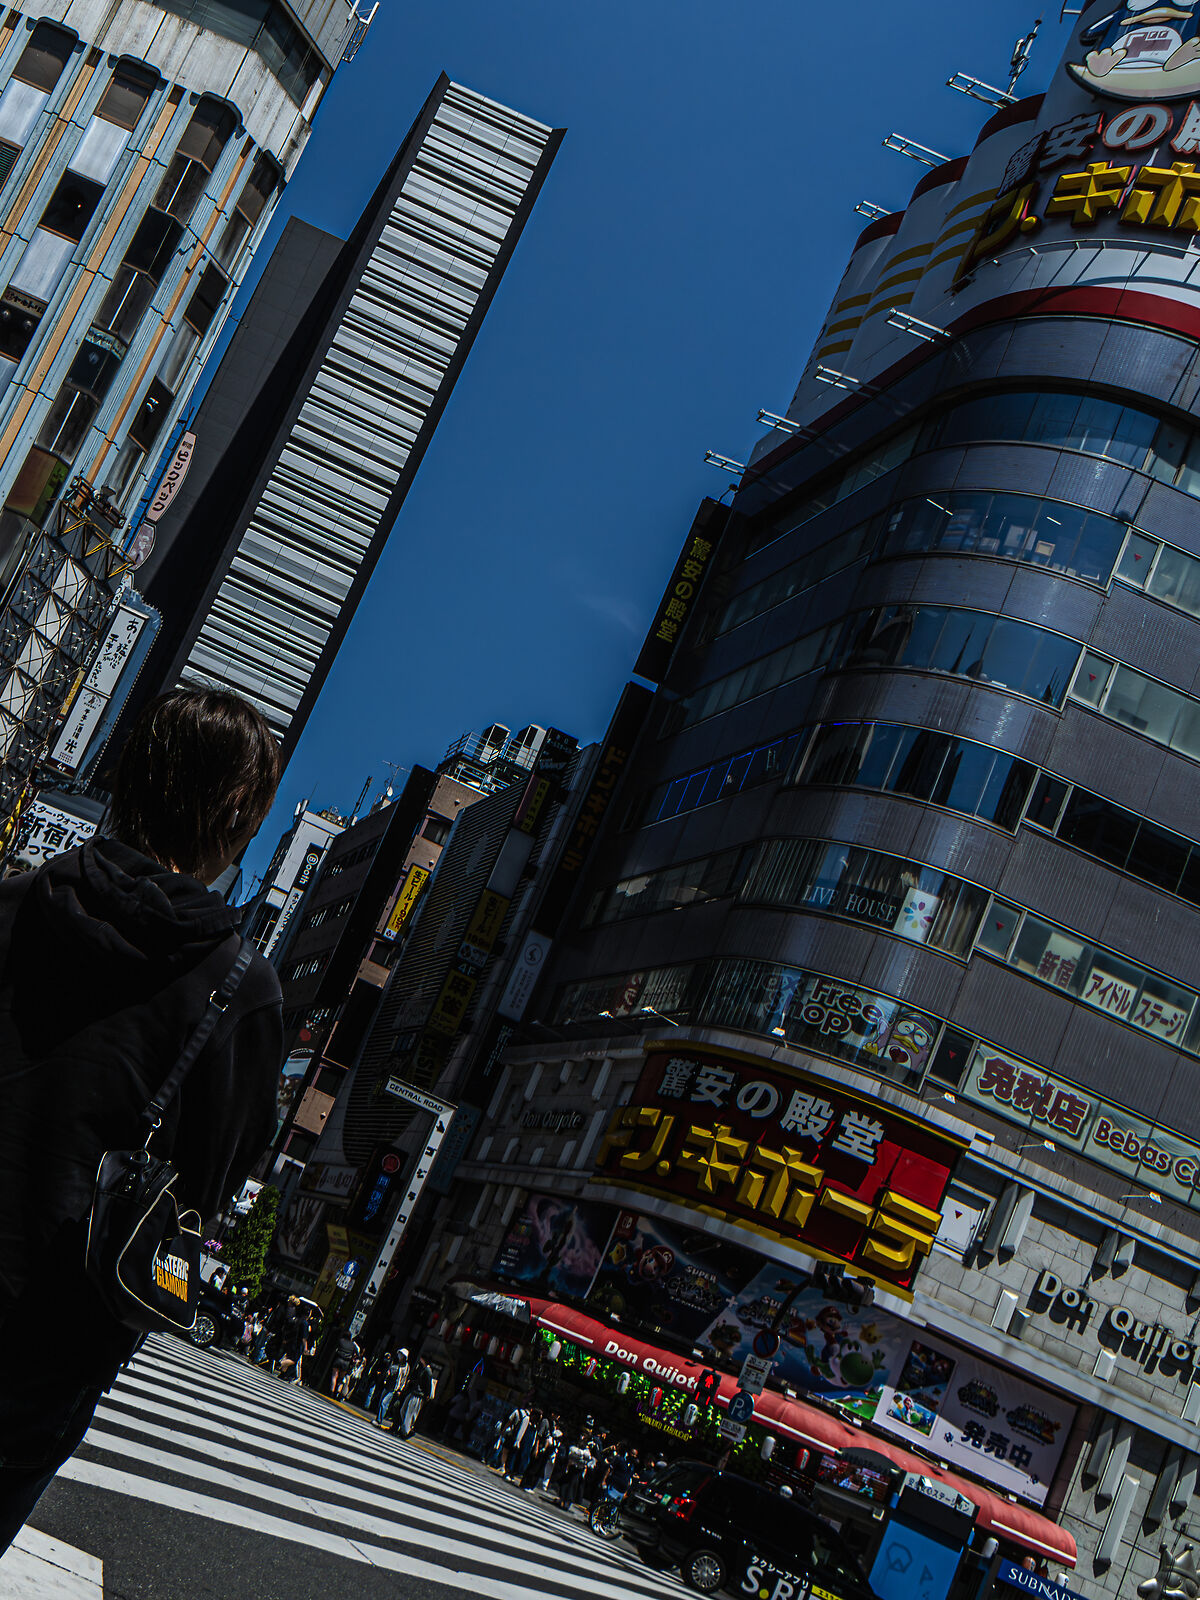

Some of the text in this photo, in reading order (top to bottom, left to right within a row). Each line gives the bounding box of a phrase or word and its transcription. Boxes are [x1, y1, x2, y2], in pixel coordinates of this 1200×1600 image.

[656, 535, 713, 644] 驚安の殿堂
[64, 738, 78, 754] 光
[19, 811, 85, 851] 新宿に
[299, 852, 319, 886] Booth
[809, 977, 886, 1025] Free
[1036, 949, 1186, 1039] 新宿 アイドル ステージ
[389, 1083, 444, 1114] CENTRAL ROAD
[656, 1055, 886, 1167] 驚安の殿堂
[977, 1054, 1091, 1138] 免税店
[1093, 1116, 1172, 1174] Bebas
[1037, 1270, 1101, 1317] Don
[604, 1340, 640, 1366] Don
